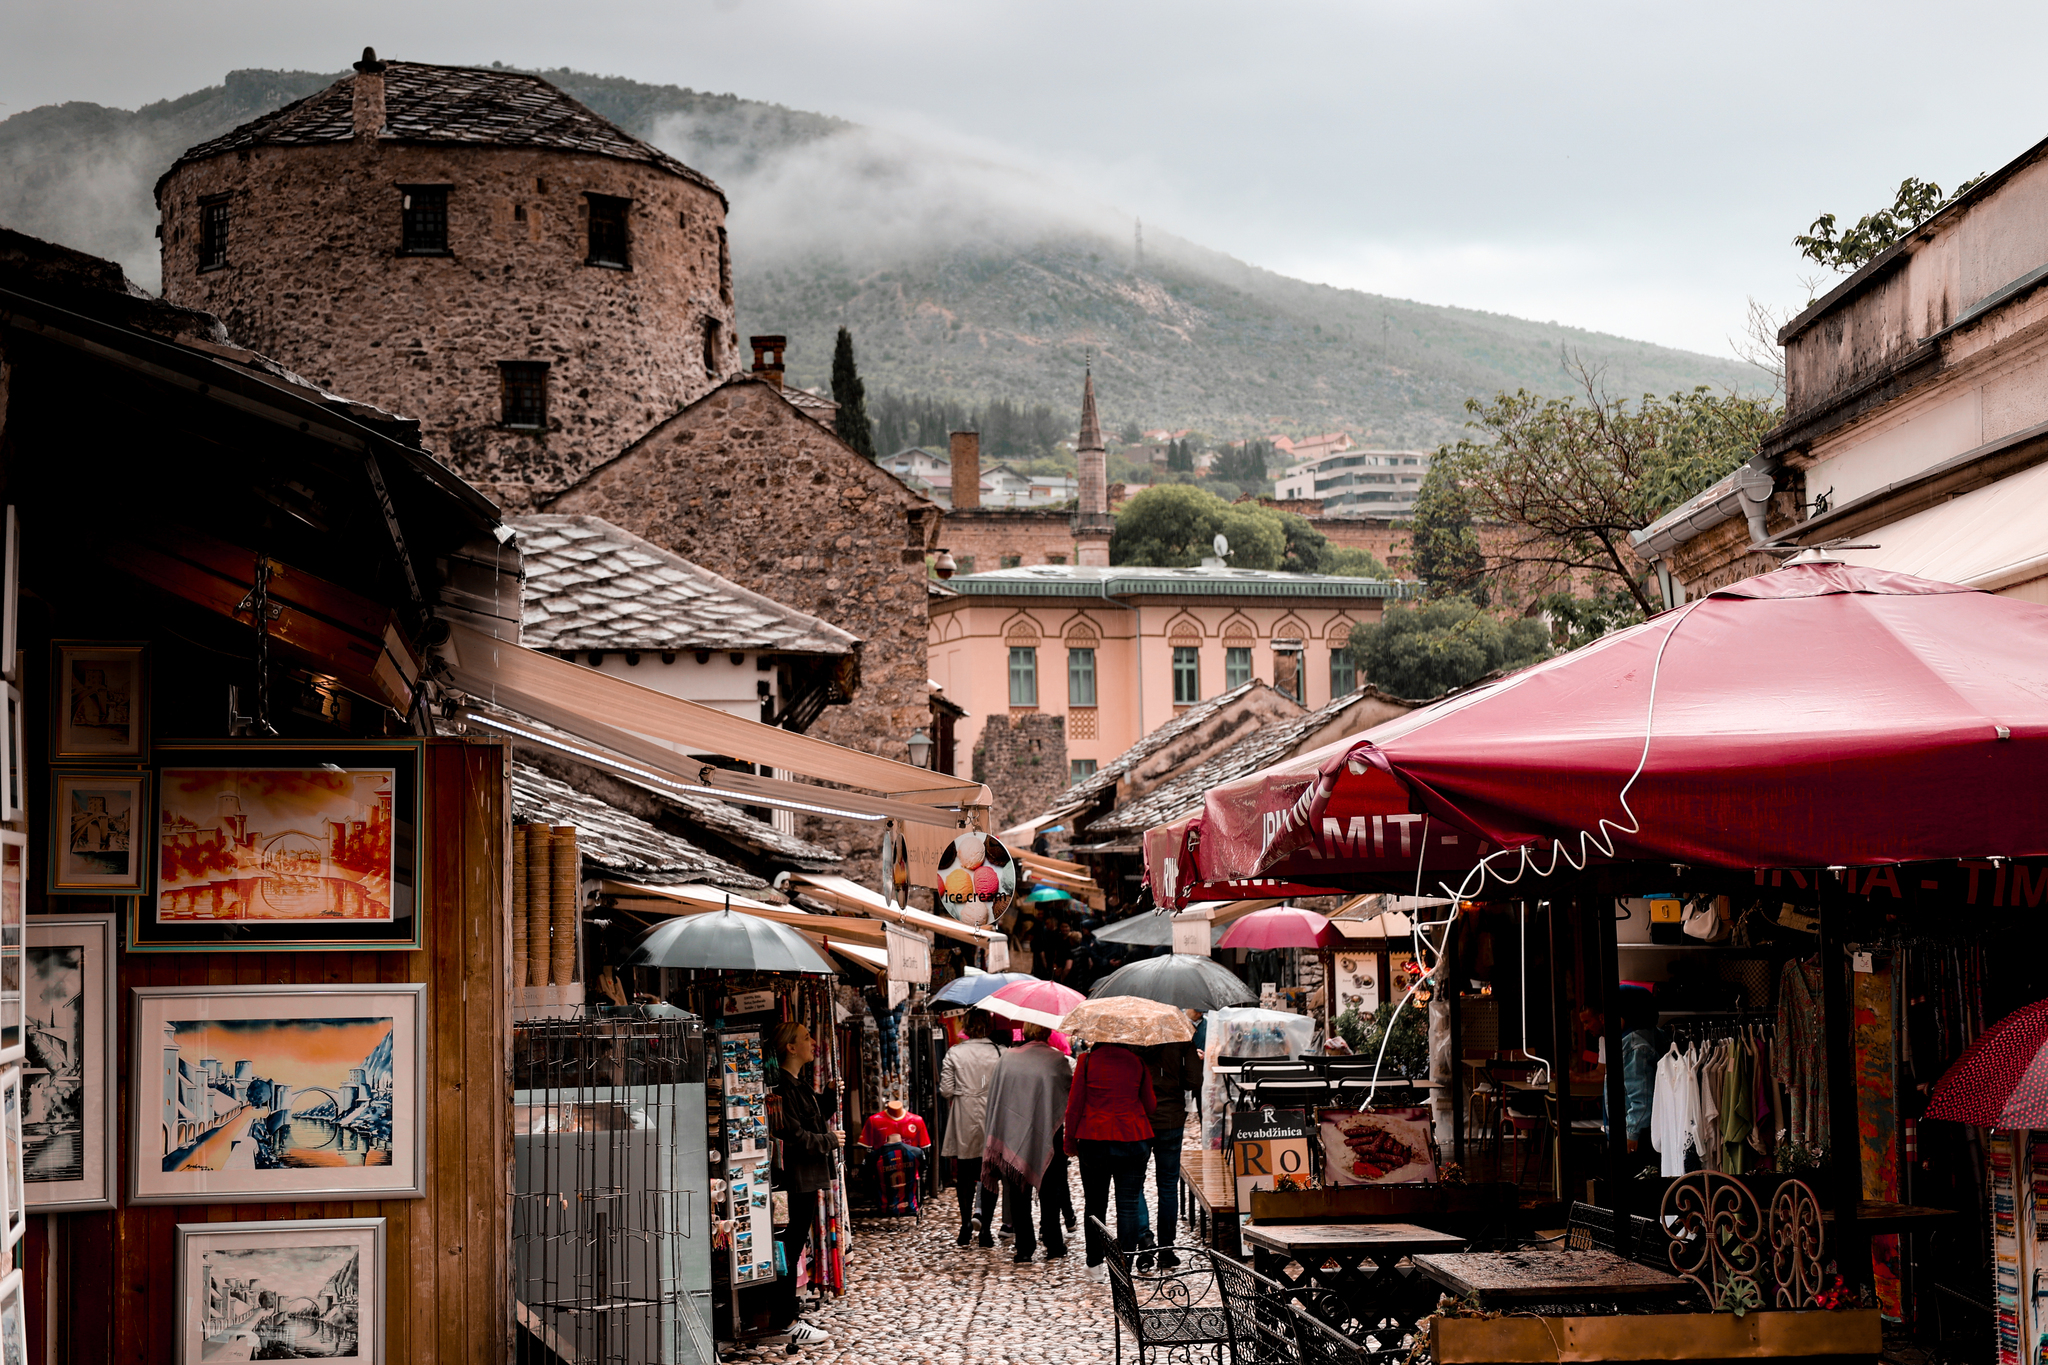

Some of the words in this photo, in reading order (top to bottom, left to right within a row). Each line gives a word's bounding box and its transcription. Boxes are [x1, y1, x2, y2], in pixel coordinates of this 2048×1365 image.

[945, 890, 963, 904] ice
[966, 891, 1007, 903] cream
[1236, 1127, 1303, 1139] ćevabdžinica
